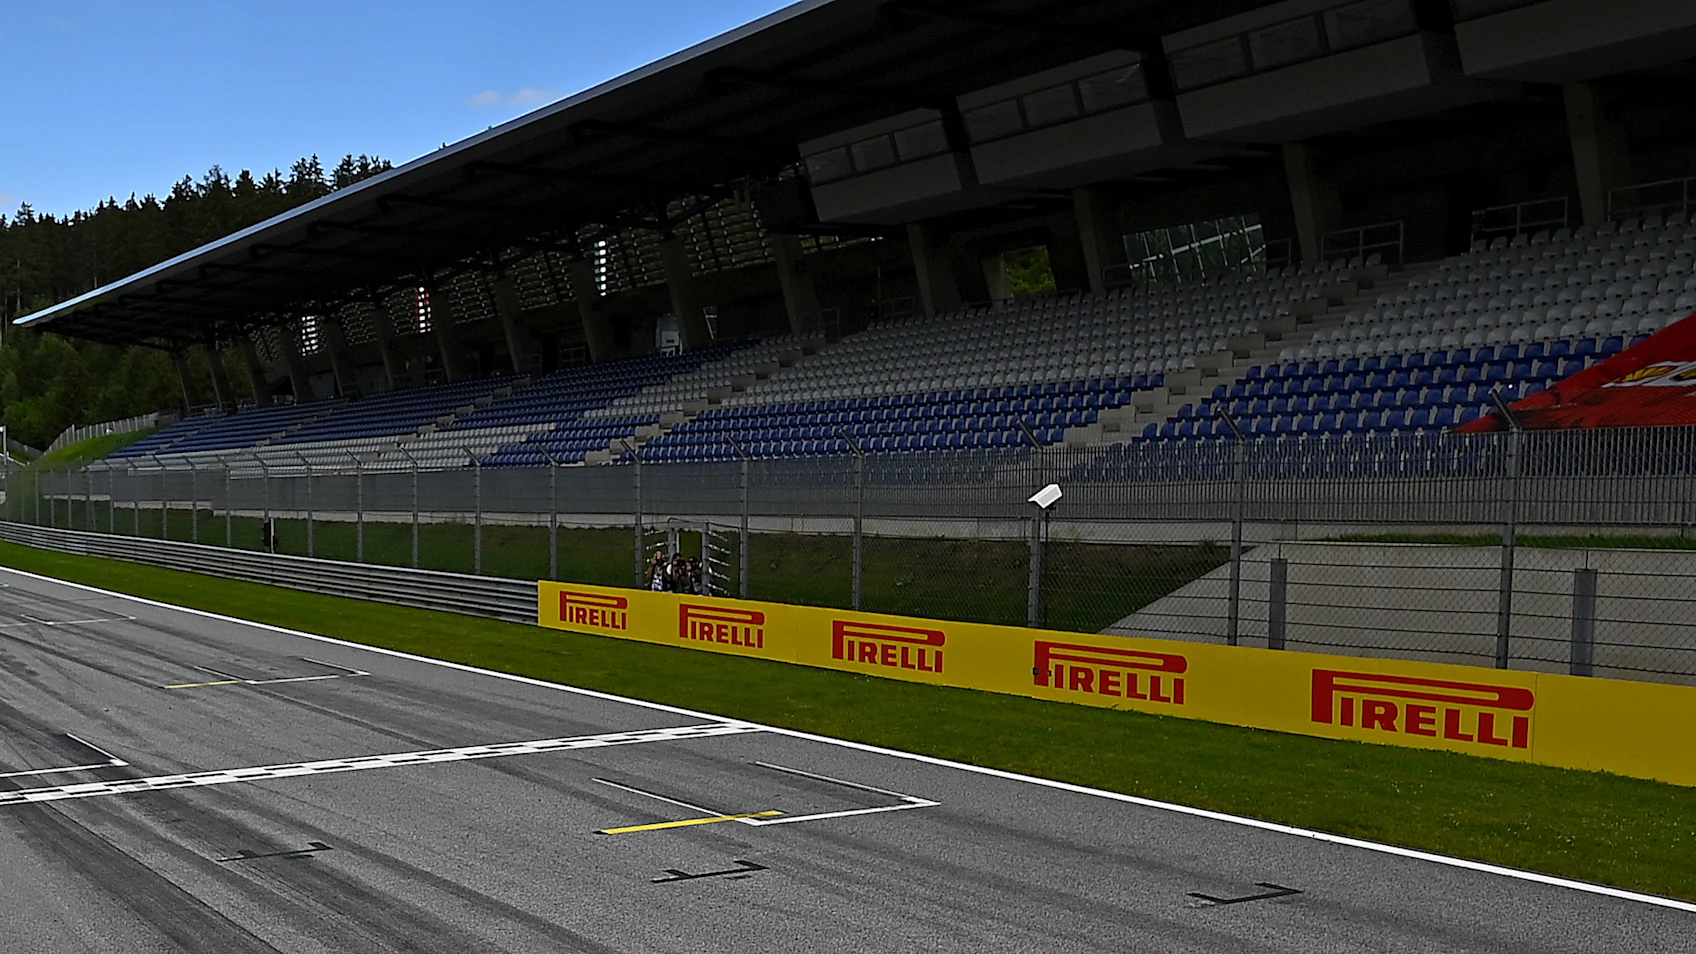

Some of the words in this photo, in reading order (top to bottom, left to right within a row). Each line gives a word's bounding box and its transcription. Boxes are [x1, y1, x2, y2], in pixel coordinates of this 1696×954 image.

[560, 590, 628, 630] PIRELLI
[679, 603, 765, 649] PIRELLI
[832, 620, 946, 674] PIRELLI
[1033, 640, 1188, 705] PIRELLI
[1312, 668, 1534, 750] PIRELLI
